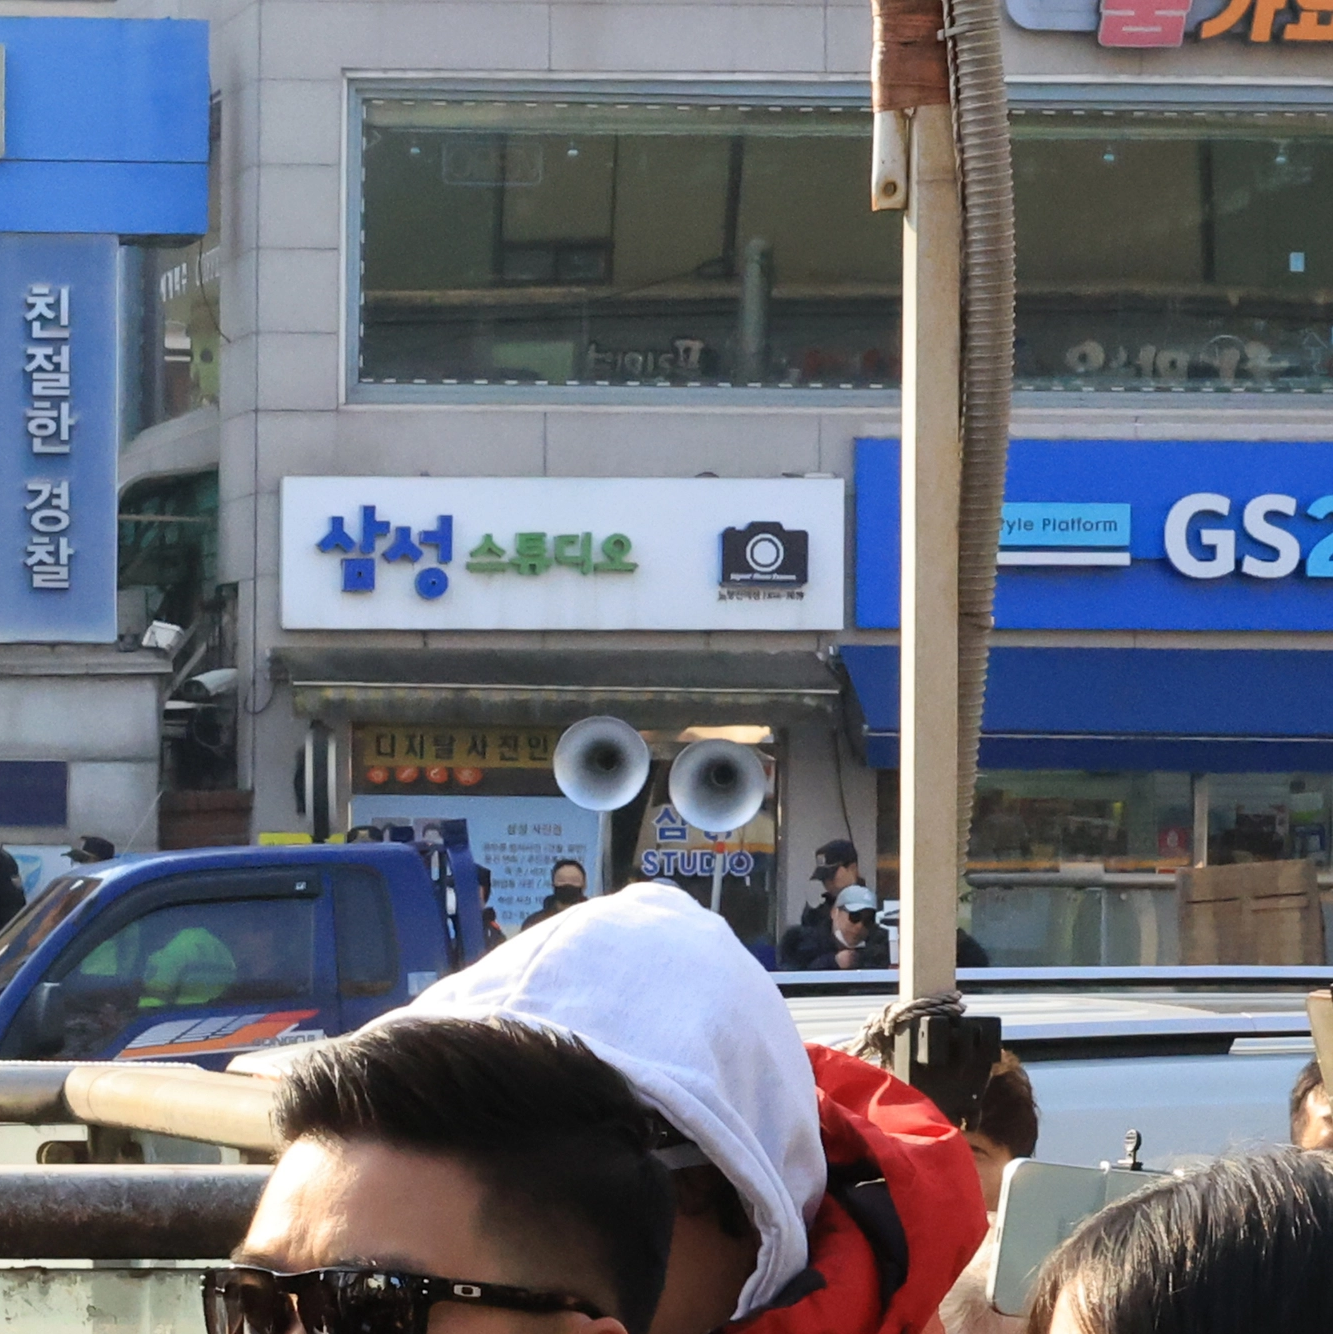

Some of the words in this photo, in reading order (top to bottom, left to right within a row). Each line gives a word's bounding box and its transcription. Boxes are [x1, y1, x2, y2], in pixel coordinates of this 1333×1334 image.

[23, 284, 75, 455] 친절한
[24, 480, 75, 590] 경찰
[316, 504, 454, 600] 삼성
[465, 531, 639, 576] 스튜디오
[1000, 517, 1034, 536] yle
[1041, 515, 1119, 533] Platform
[653, 805, 733, 842] 삼
[641, 849, 754, 877] STUDIO
